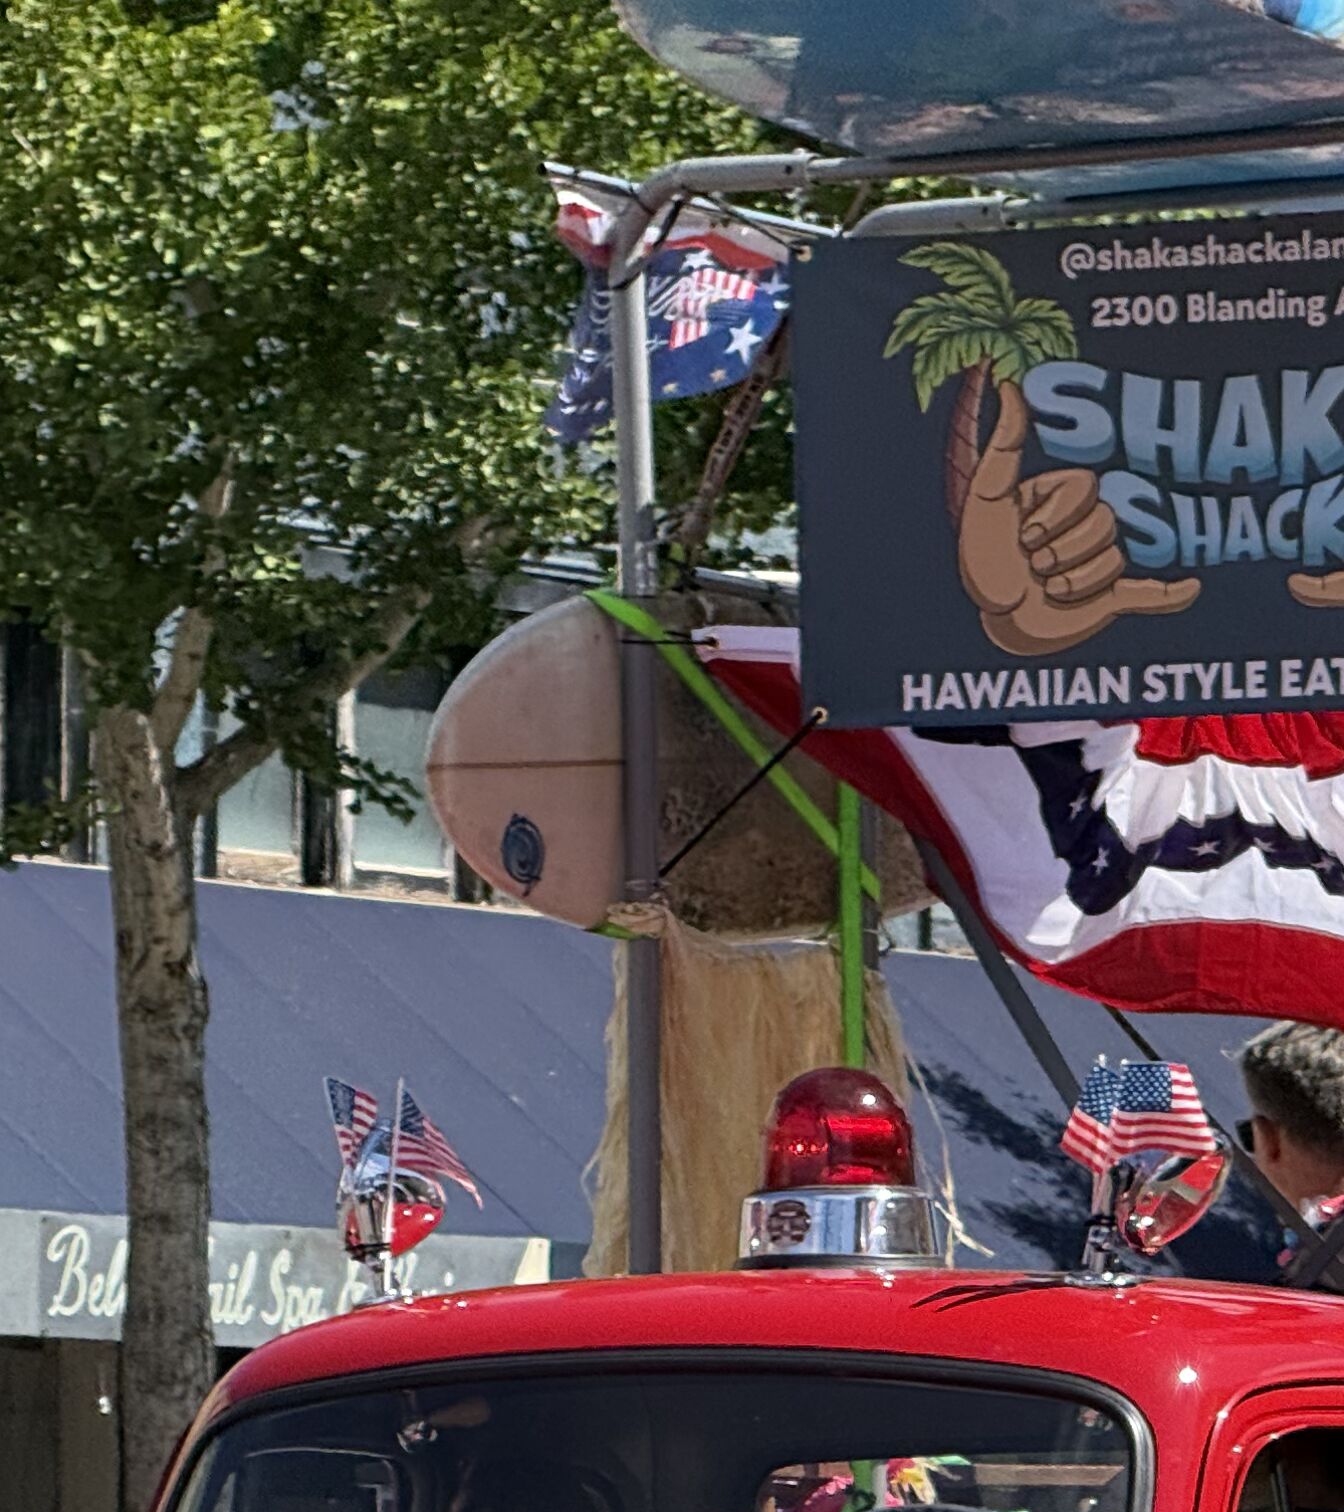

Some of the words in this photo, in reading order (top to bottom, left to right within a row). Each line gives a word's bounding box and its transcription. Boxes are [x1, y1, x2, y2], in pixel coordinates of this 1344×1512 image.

[1091, 295, 1178, 328] 2300
[1187, 288, 1327, 327] Blanding
[902, 666, 1130, 711] HAWAIIAN
[1142, 660, 1267, 702] STYLE
[46, 1223, 128, 1318] Bel
